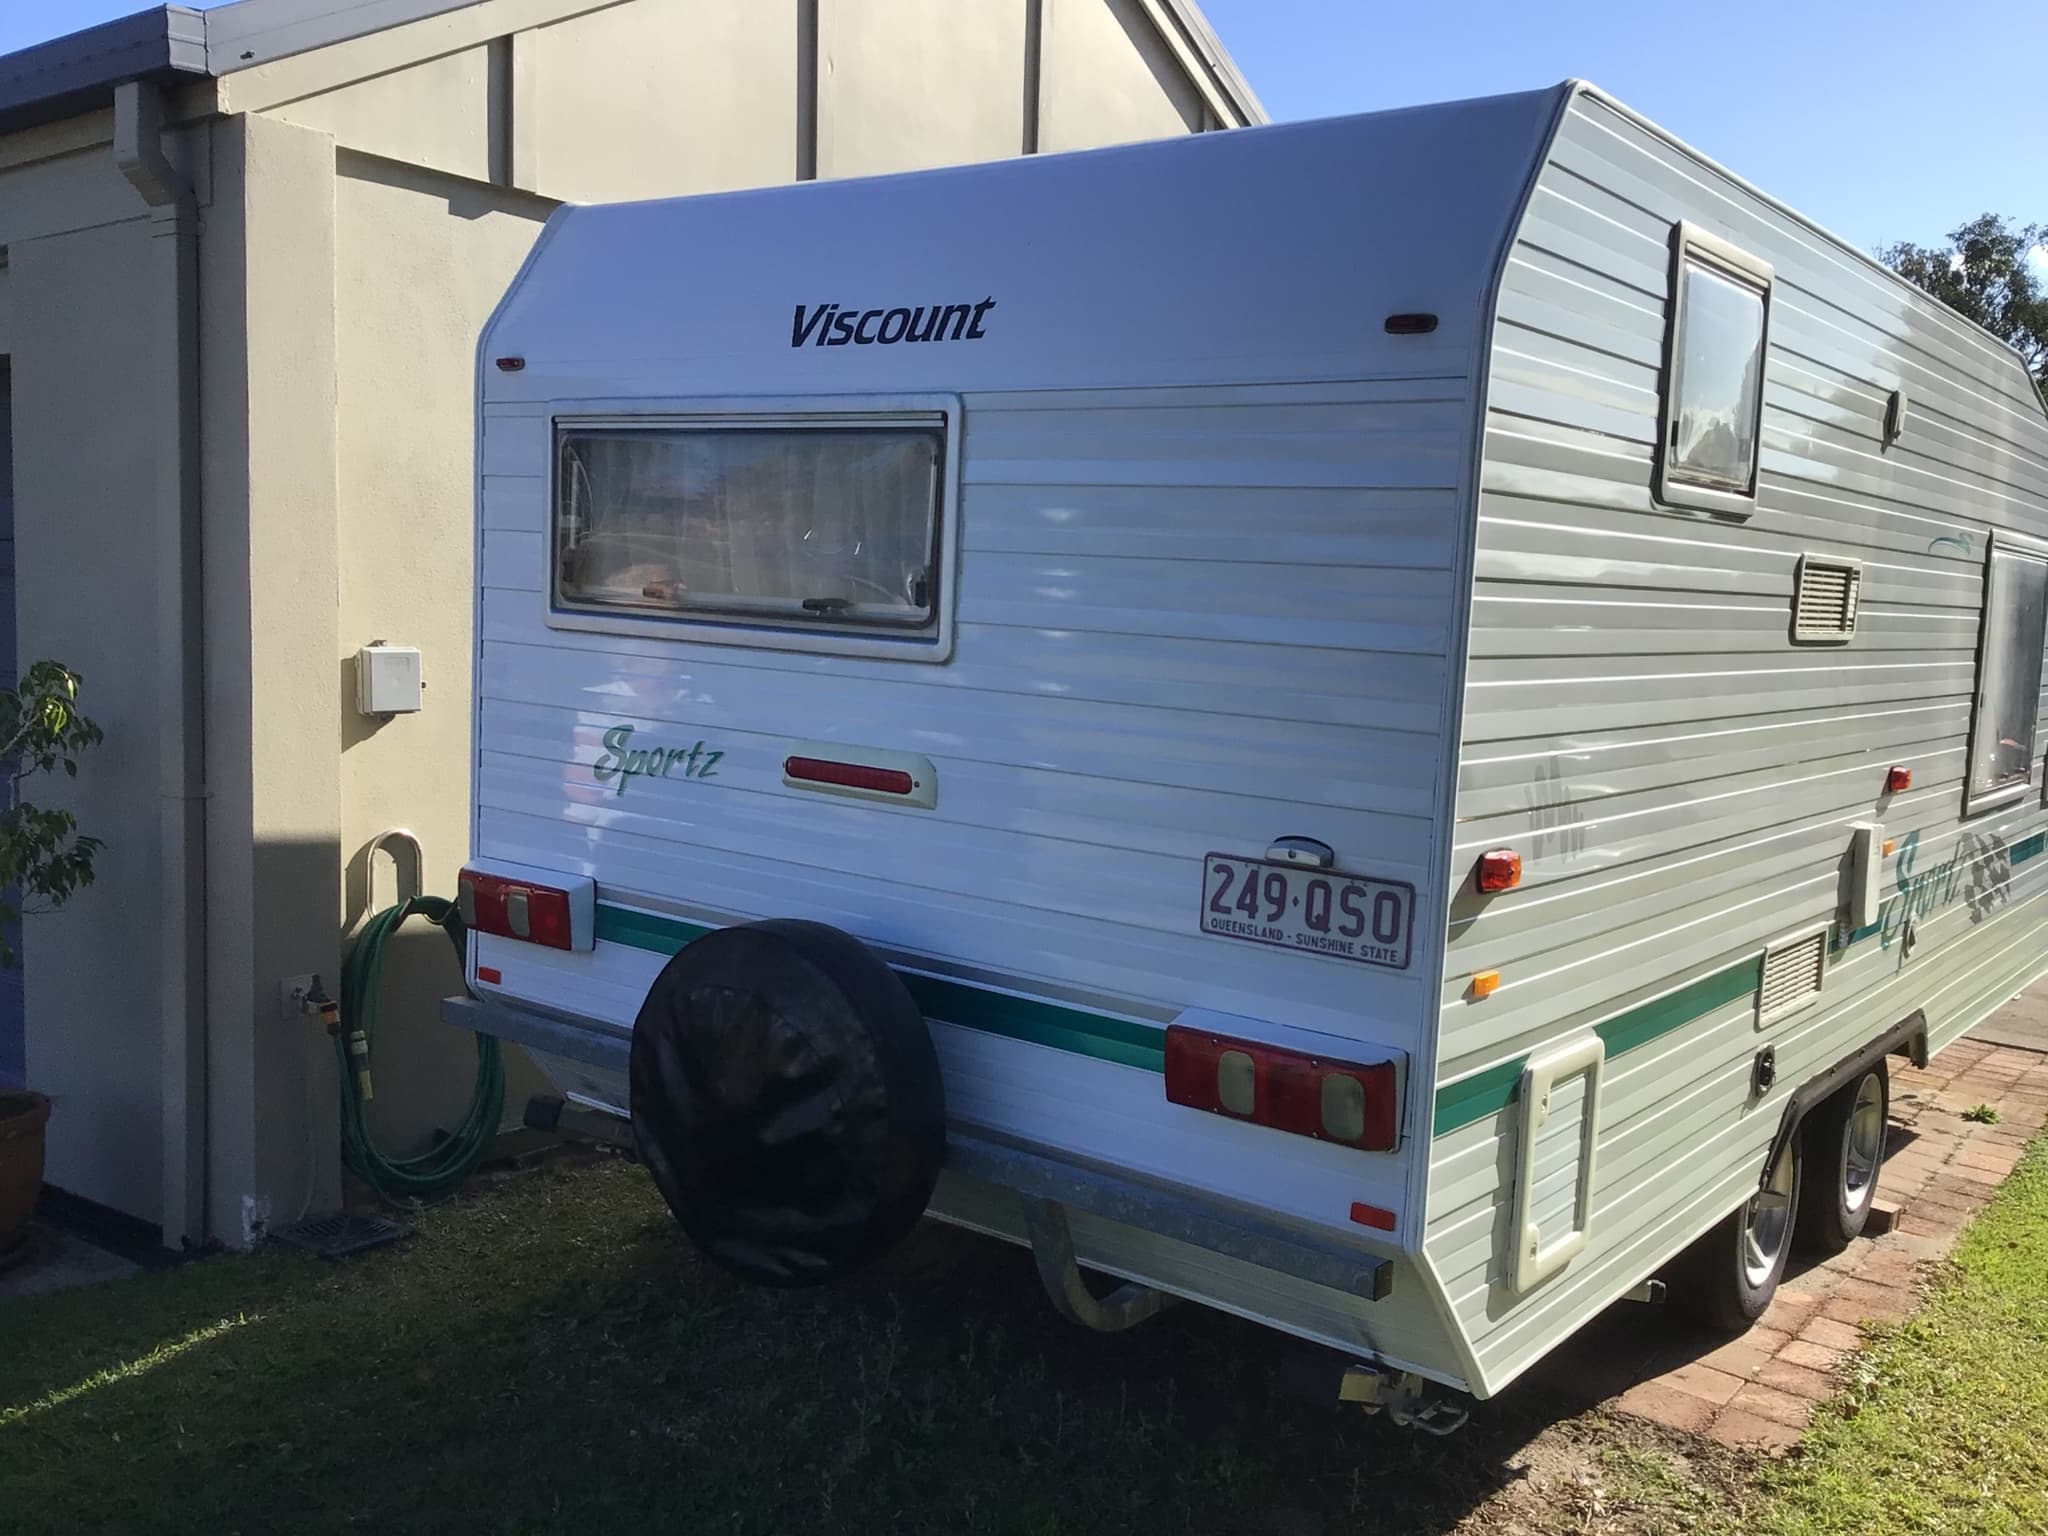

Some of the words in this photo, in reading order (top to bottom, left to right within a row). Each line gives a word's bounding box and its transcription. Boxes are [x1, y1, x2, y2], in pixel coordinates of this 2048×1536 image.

[791, 296, 997, 348] Viscount
[593, 724, 725, 797] Sportz
[1210, 917, 1284, 942] QUEENSLAND
[1295, 932, 1355, 955] SUNSHINE
[1359, 943, 1398, 963] STATE
